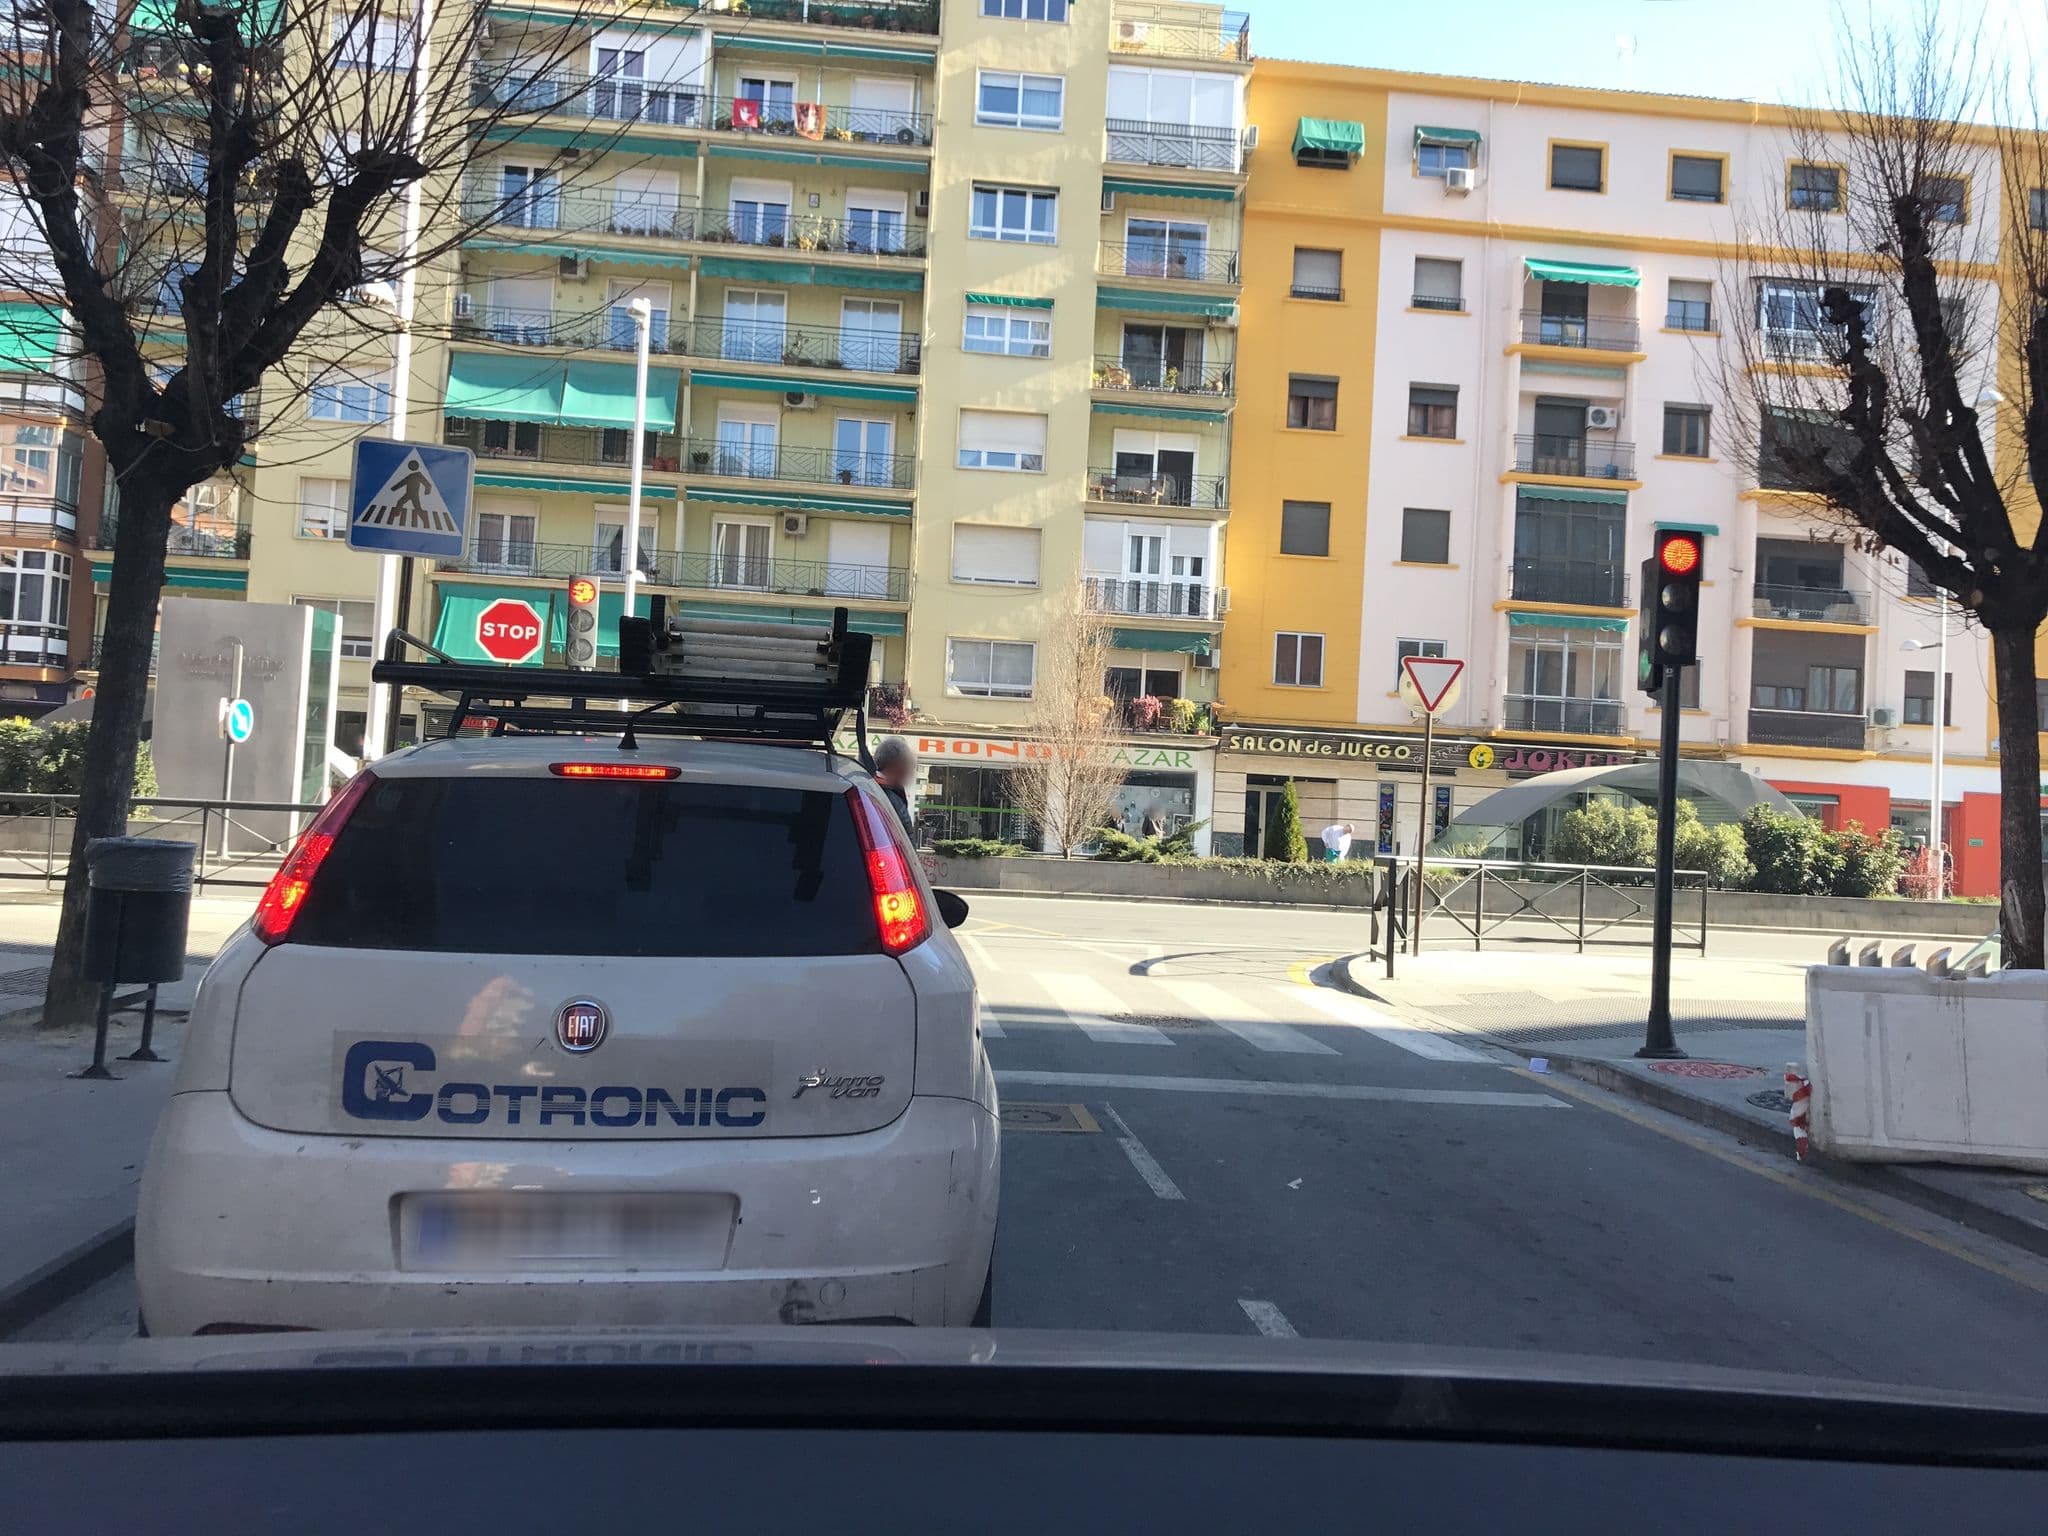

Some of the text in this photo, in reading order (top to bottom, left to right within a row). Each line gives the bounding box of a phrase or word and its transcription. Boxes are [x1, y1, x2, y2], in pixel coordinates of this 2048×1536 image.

[482, 622, 537, 640] STOP
[1229, 736, 1411, 760] SALON de JUEGO
[567, 1015, 598, 1038] FIAT
[342, 1040, 767, 1128] COTRONIC
